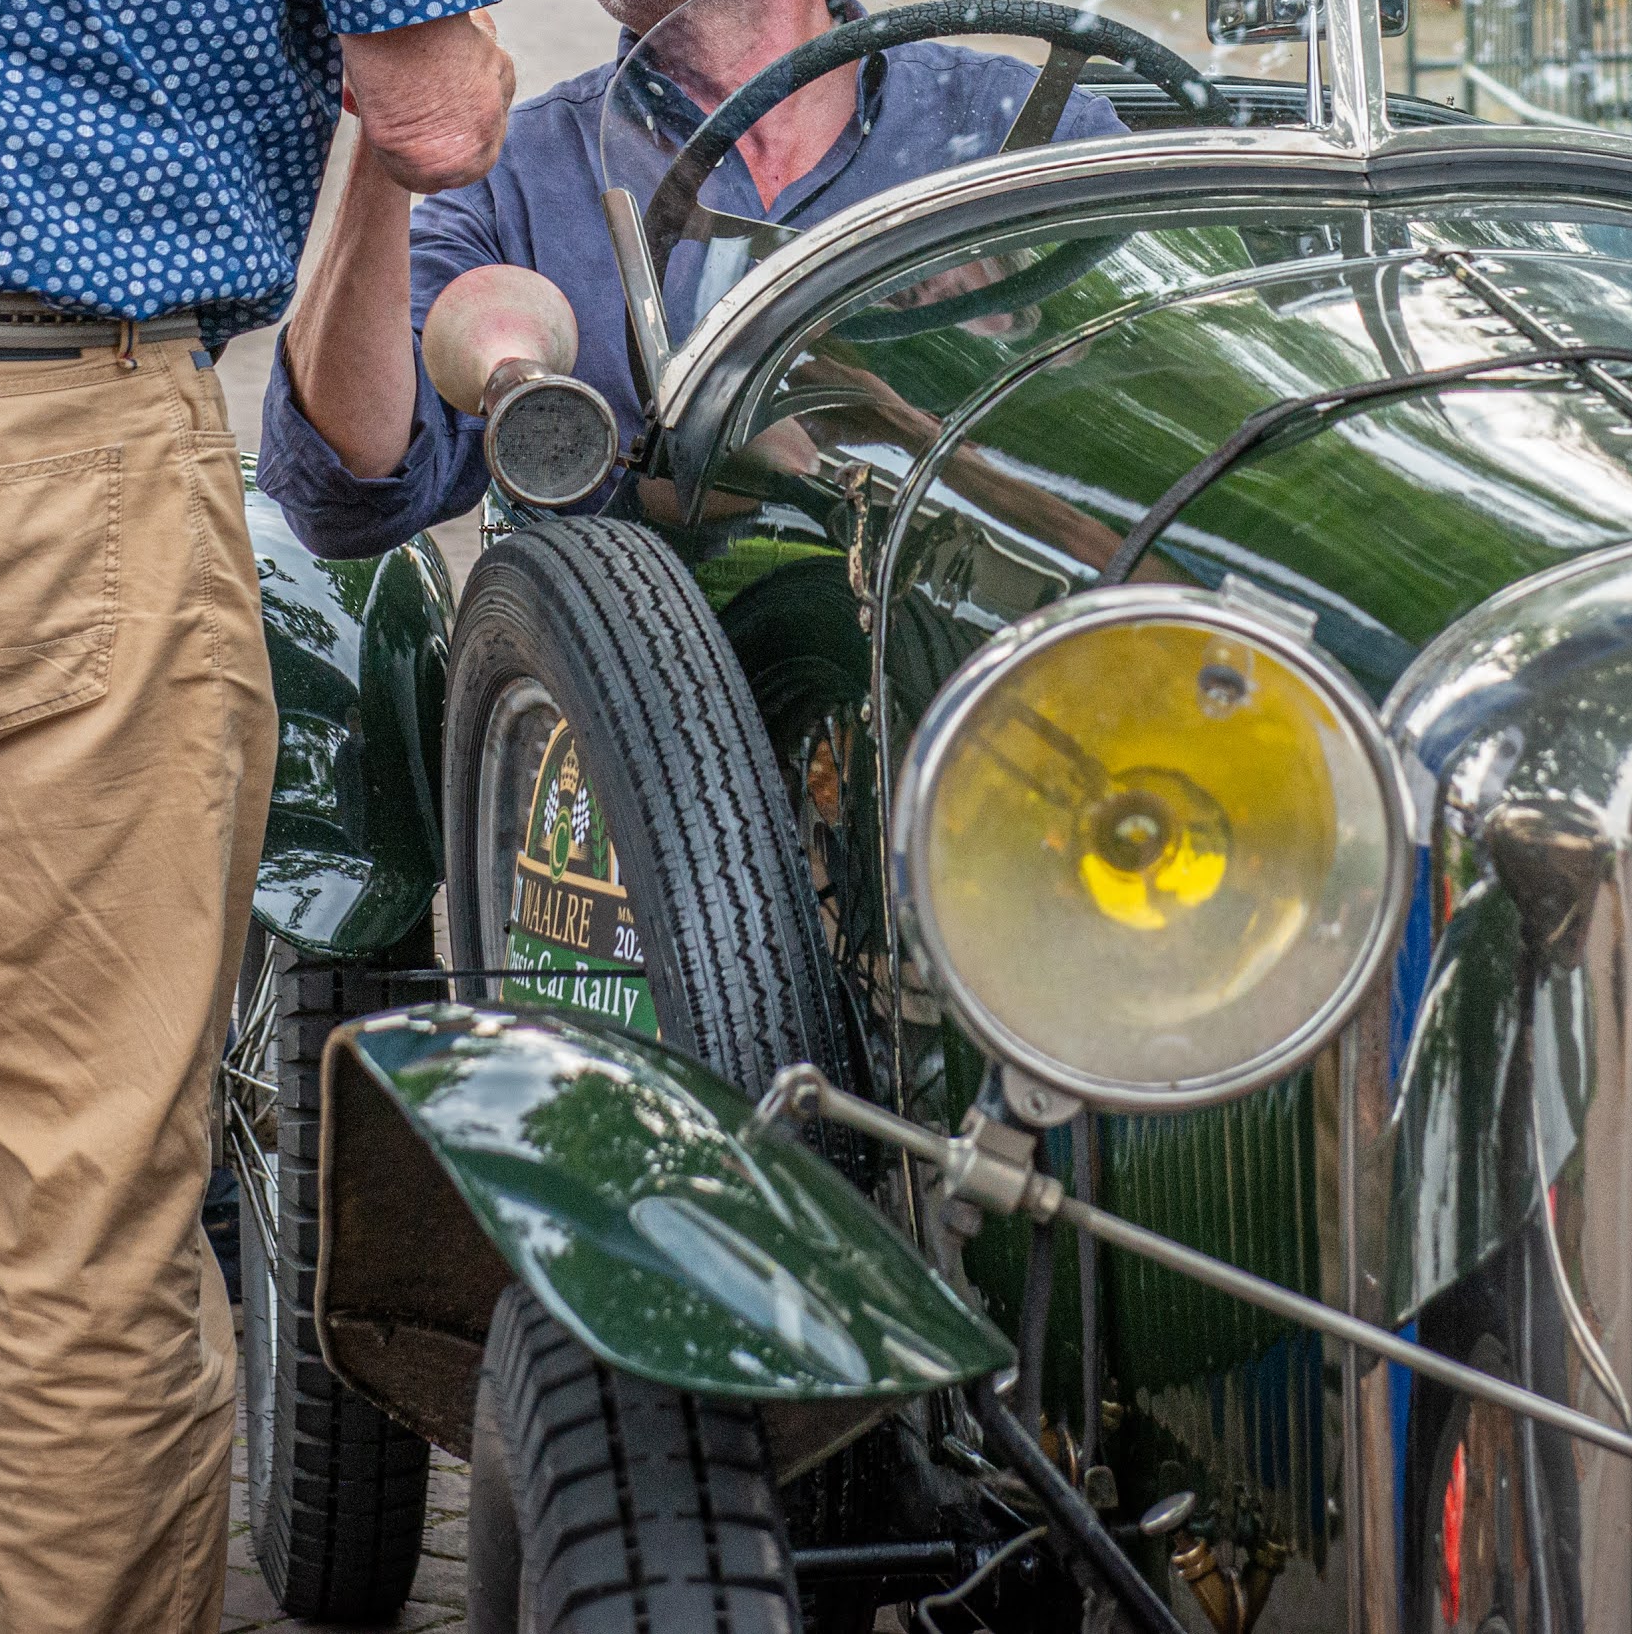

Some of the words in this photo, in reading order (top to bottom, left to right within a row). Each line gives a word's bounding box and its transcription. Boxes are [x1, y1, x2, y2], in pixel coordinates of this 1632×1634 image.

[522, 879, 594, 949] WAALRE
[536, 950, 567, 1001] Car
[571, 961, 639, 1029] Rally
